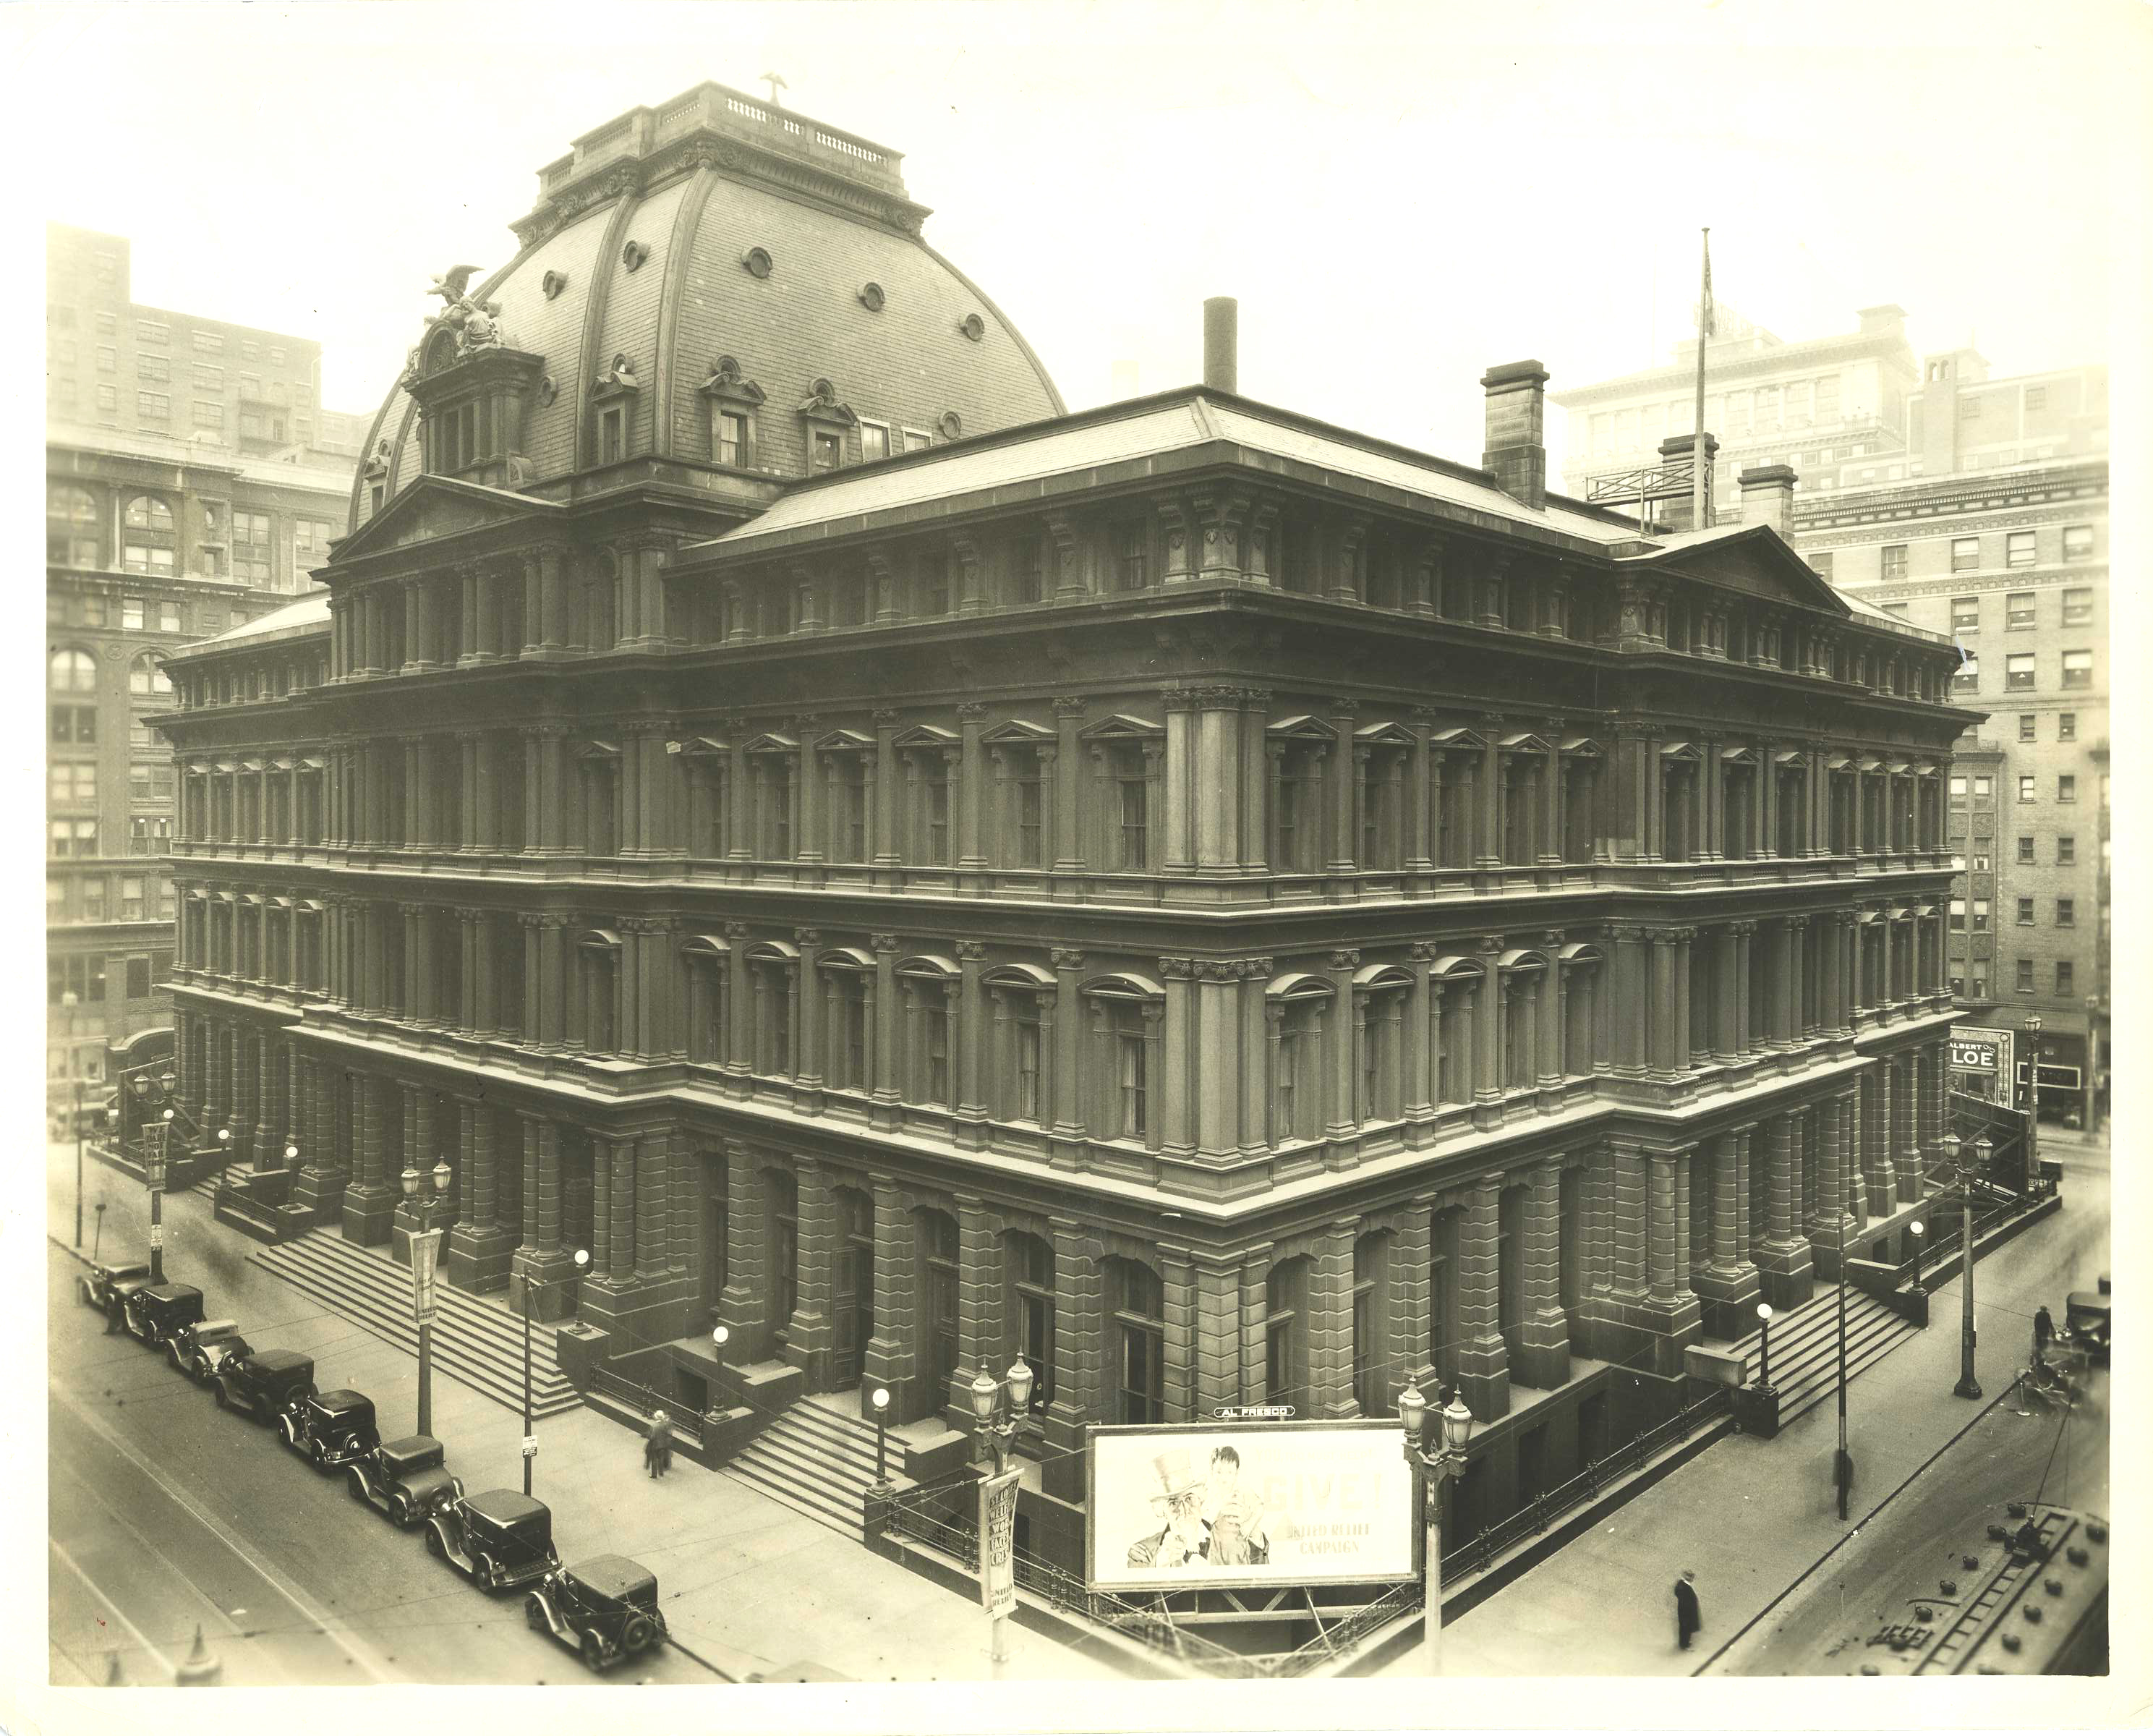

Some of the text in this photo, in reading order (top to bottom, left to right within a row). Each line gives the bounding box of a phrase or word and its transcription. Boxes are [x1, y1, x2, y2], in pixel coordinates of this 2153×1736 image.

[1287, 1523, 1371, 1539] UNITED RELIEF
[1300, 1541, 1360, 1554] CAMPAIGN
